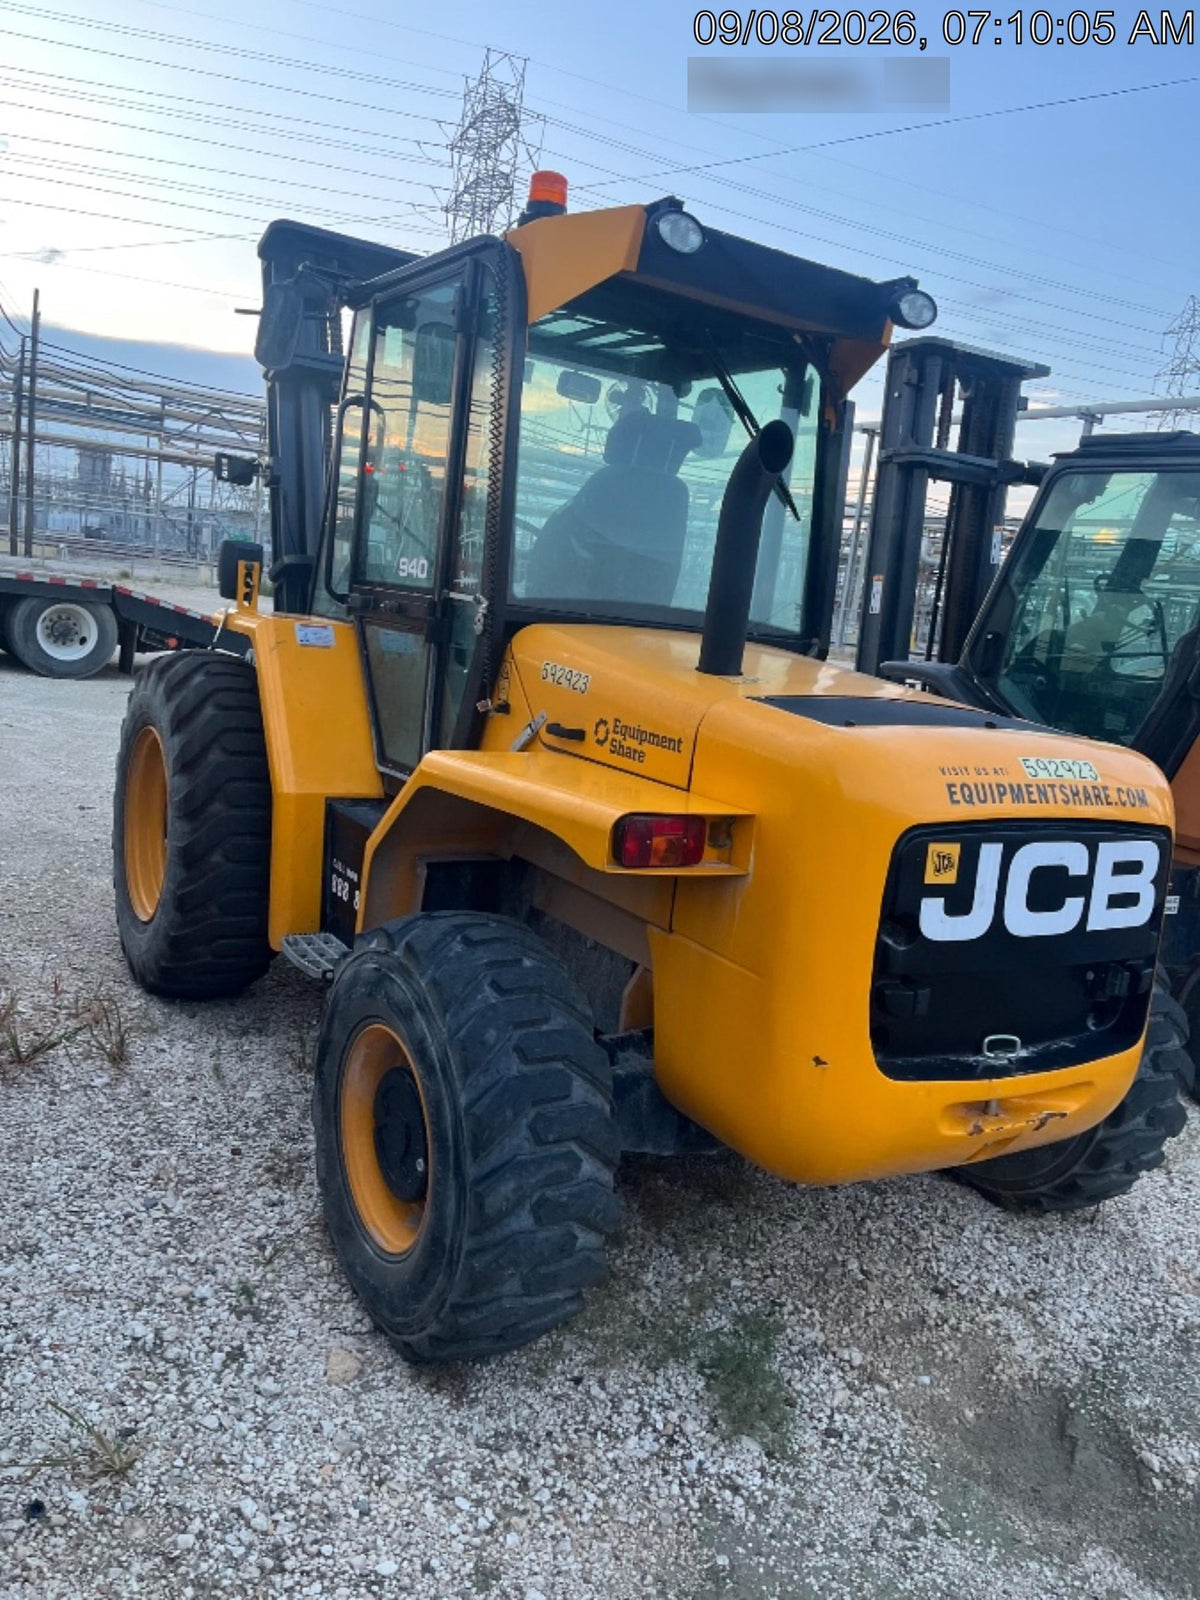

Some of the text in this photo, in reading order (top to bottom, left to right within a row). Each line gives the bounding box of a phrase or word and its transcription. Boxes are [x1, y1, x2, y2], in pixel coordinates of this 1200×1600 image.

[398, 557, 428, 578] 940
[541, 662, 590, 694] 592923
[612, 718, 683, 754] Equipment
[609, 738, 647, 763] Share
[938, 765, 970, 776] VISIT
[974, 766, 989, 776] US
[1021, 758, 1099, 781] 592923
[946, 782, 1149, 808] EQUIPMENTSHARE.COM
[932, 850, 955, 877] JCB
[919, 840, 1160, 941] JCB
